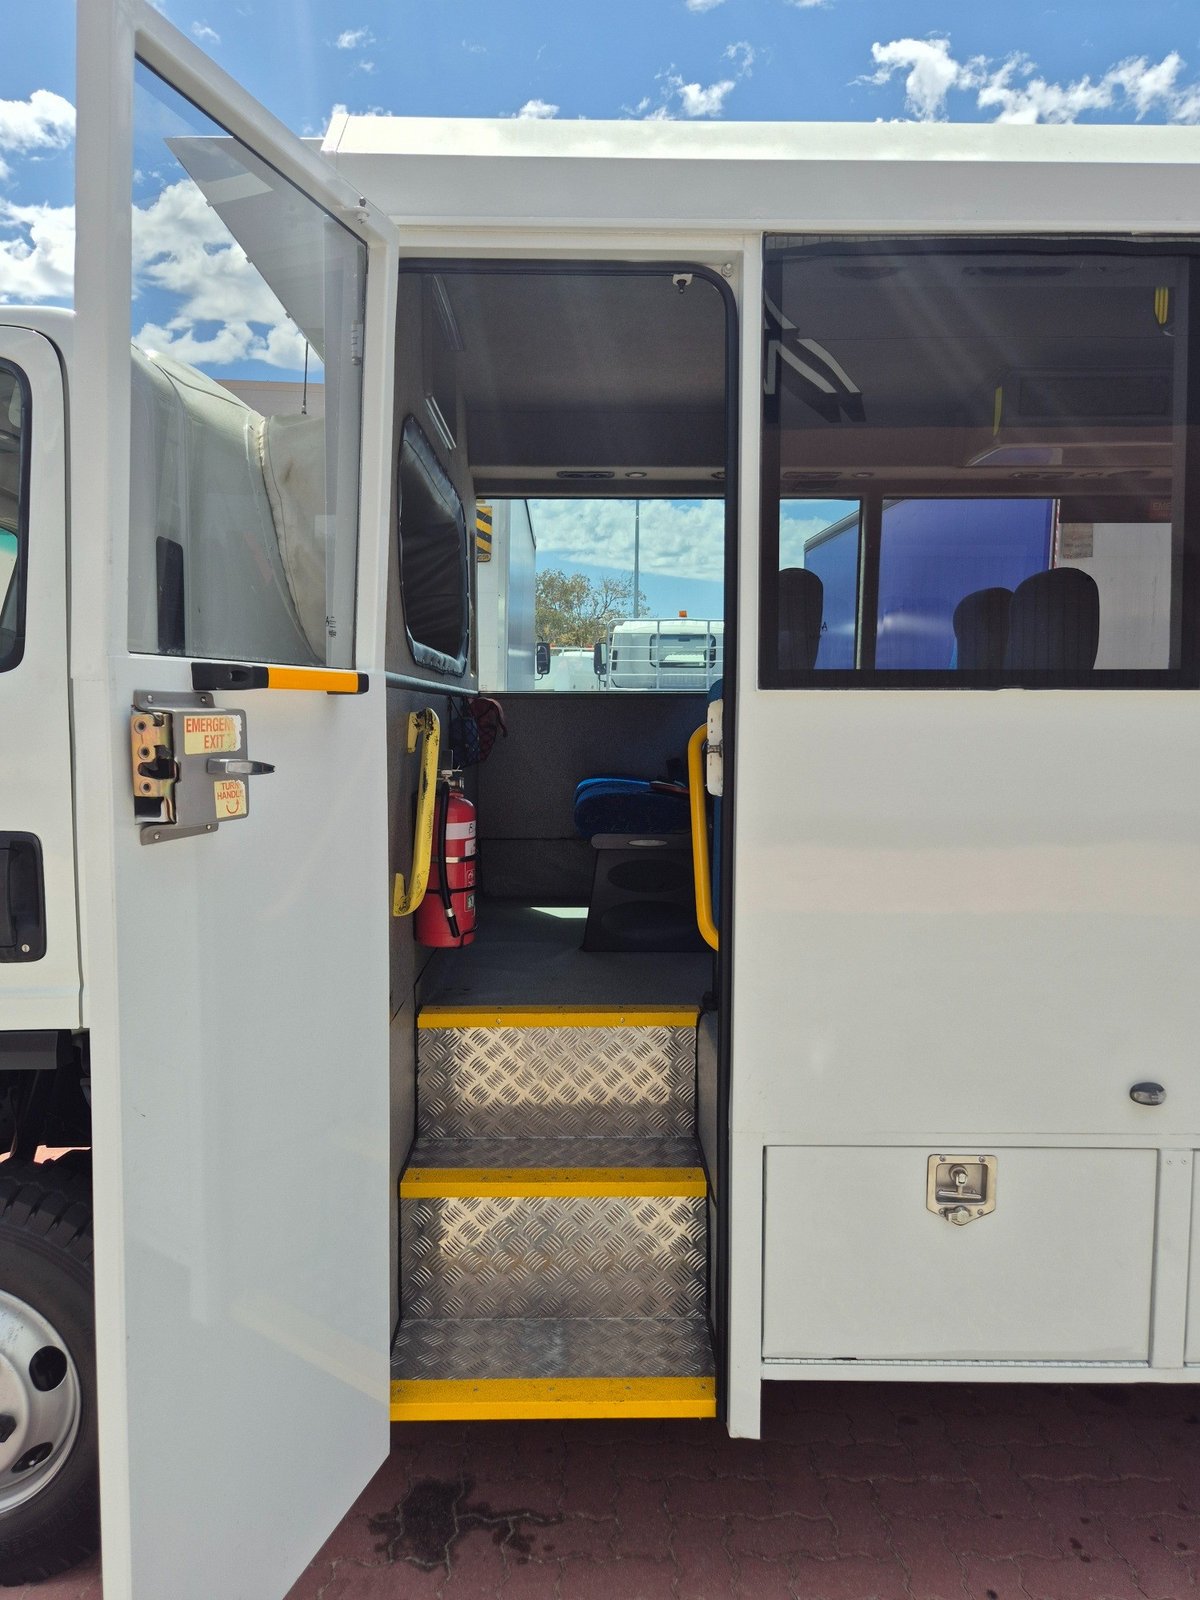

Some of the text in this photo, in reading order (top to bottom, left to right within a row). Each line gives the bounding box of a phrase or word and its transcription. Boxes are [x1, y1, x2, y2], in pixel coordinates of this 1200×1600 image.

[186, 717, 234, 733] EMERGEN
[204, 734, 224, 749] EXIT
[221, 782, 240, 791] TURN
[216, 790, 242, 800] HANDL
